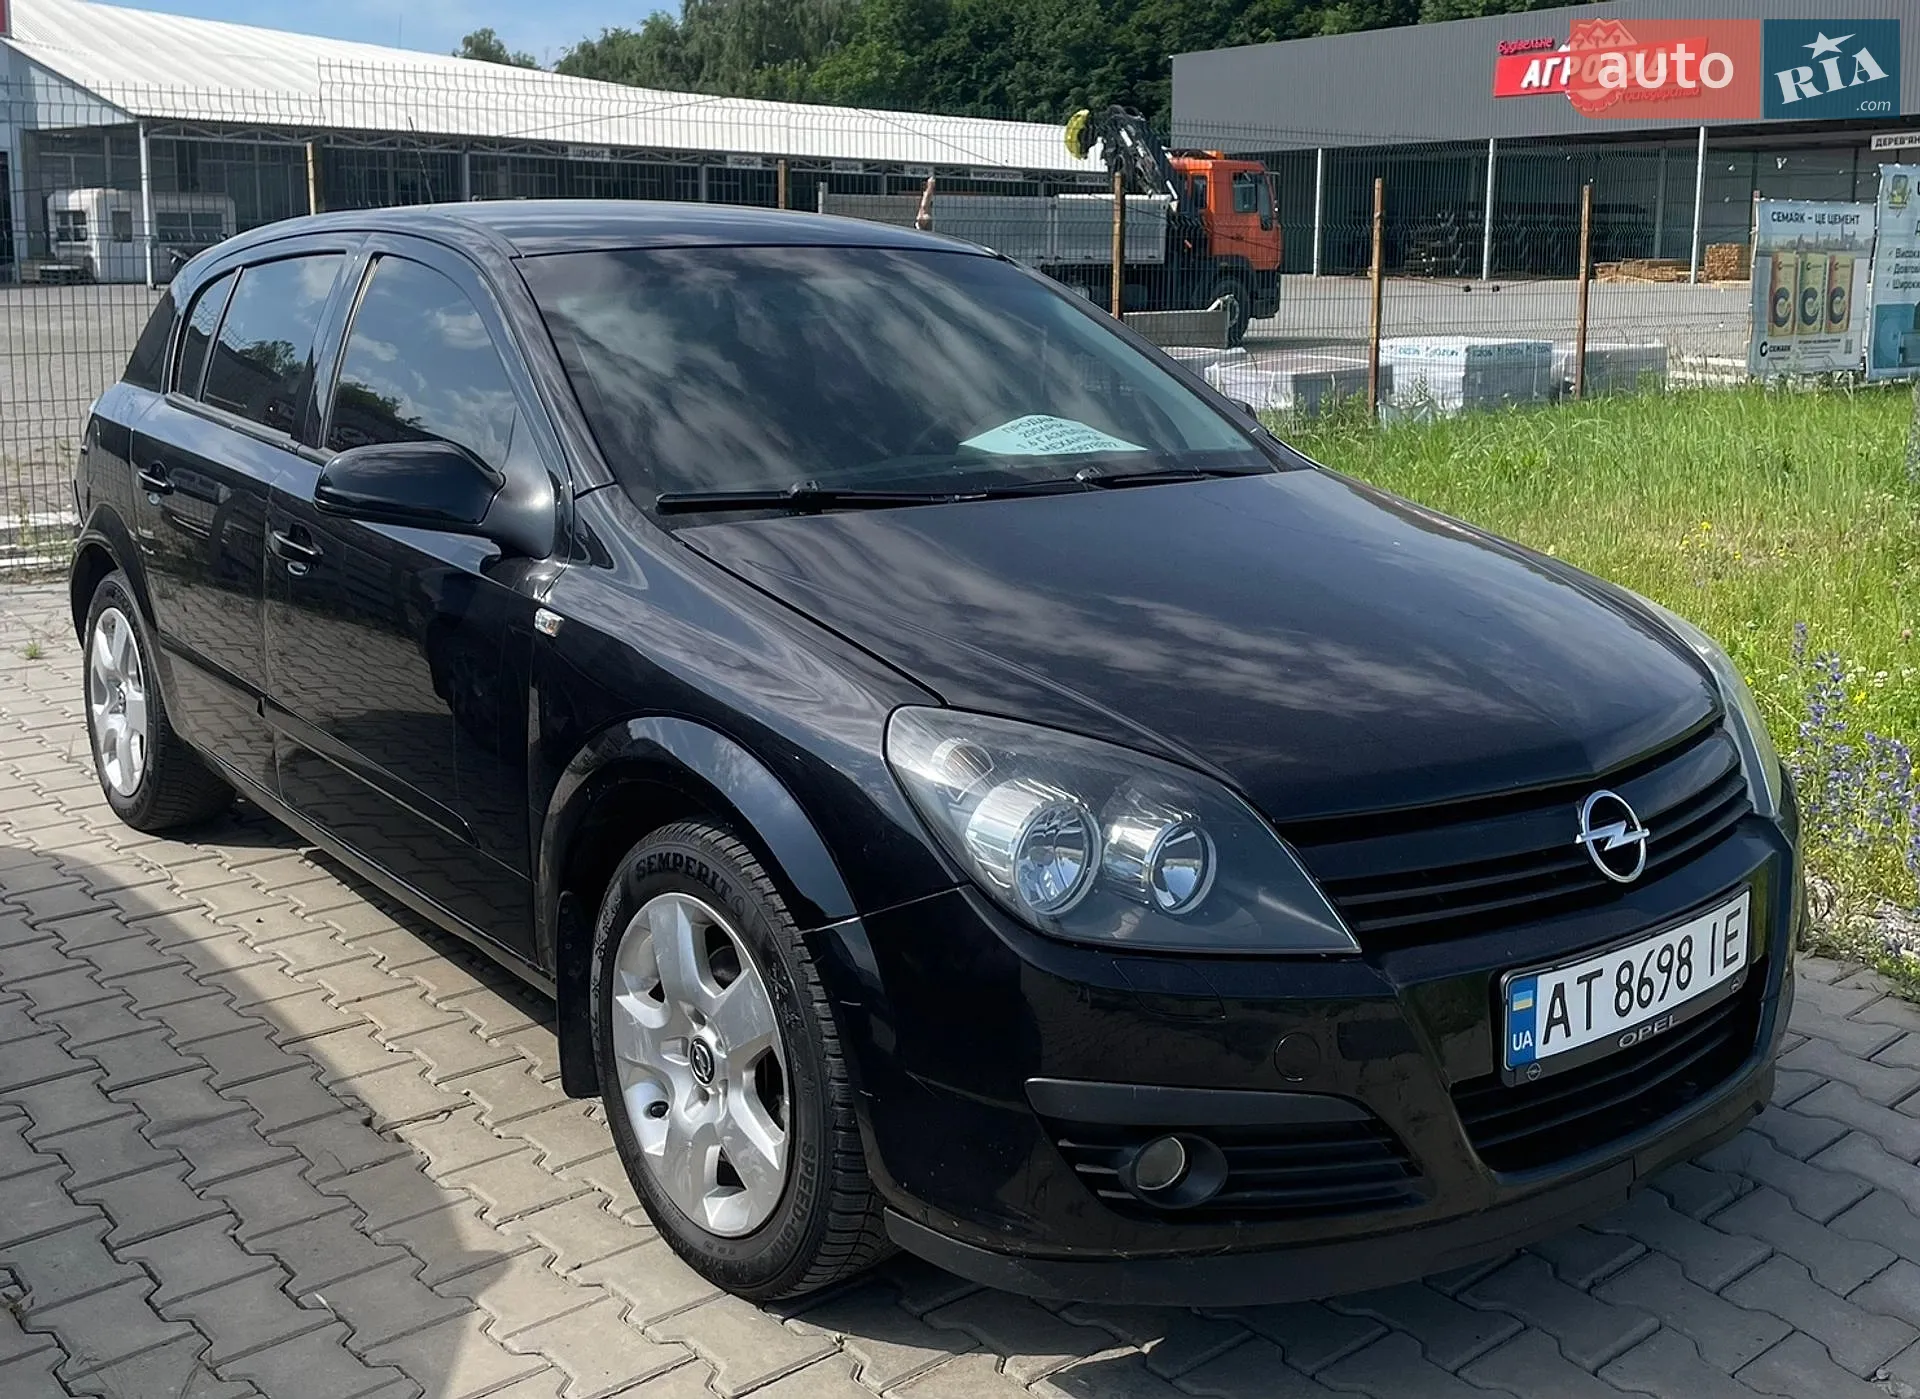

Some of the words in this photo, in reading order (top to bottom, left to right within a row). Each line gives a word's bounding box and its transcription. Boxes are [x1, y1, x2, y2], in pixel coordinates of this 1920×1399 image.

[1771, 211, 1806, 223] CEMARK
[635, 852, 733, 903] SEMPERIT
[1542, 968, 1603, 1046] AT
[1614, 934, 1693, 1018] 8698
[1710, 906, 1741, 978] IE
[1512, 1030, 1533, 1051] UA
[1618, 1014, 1682, 1048] OPEL
